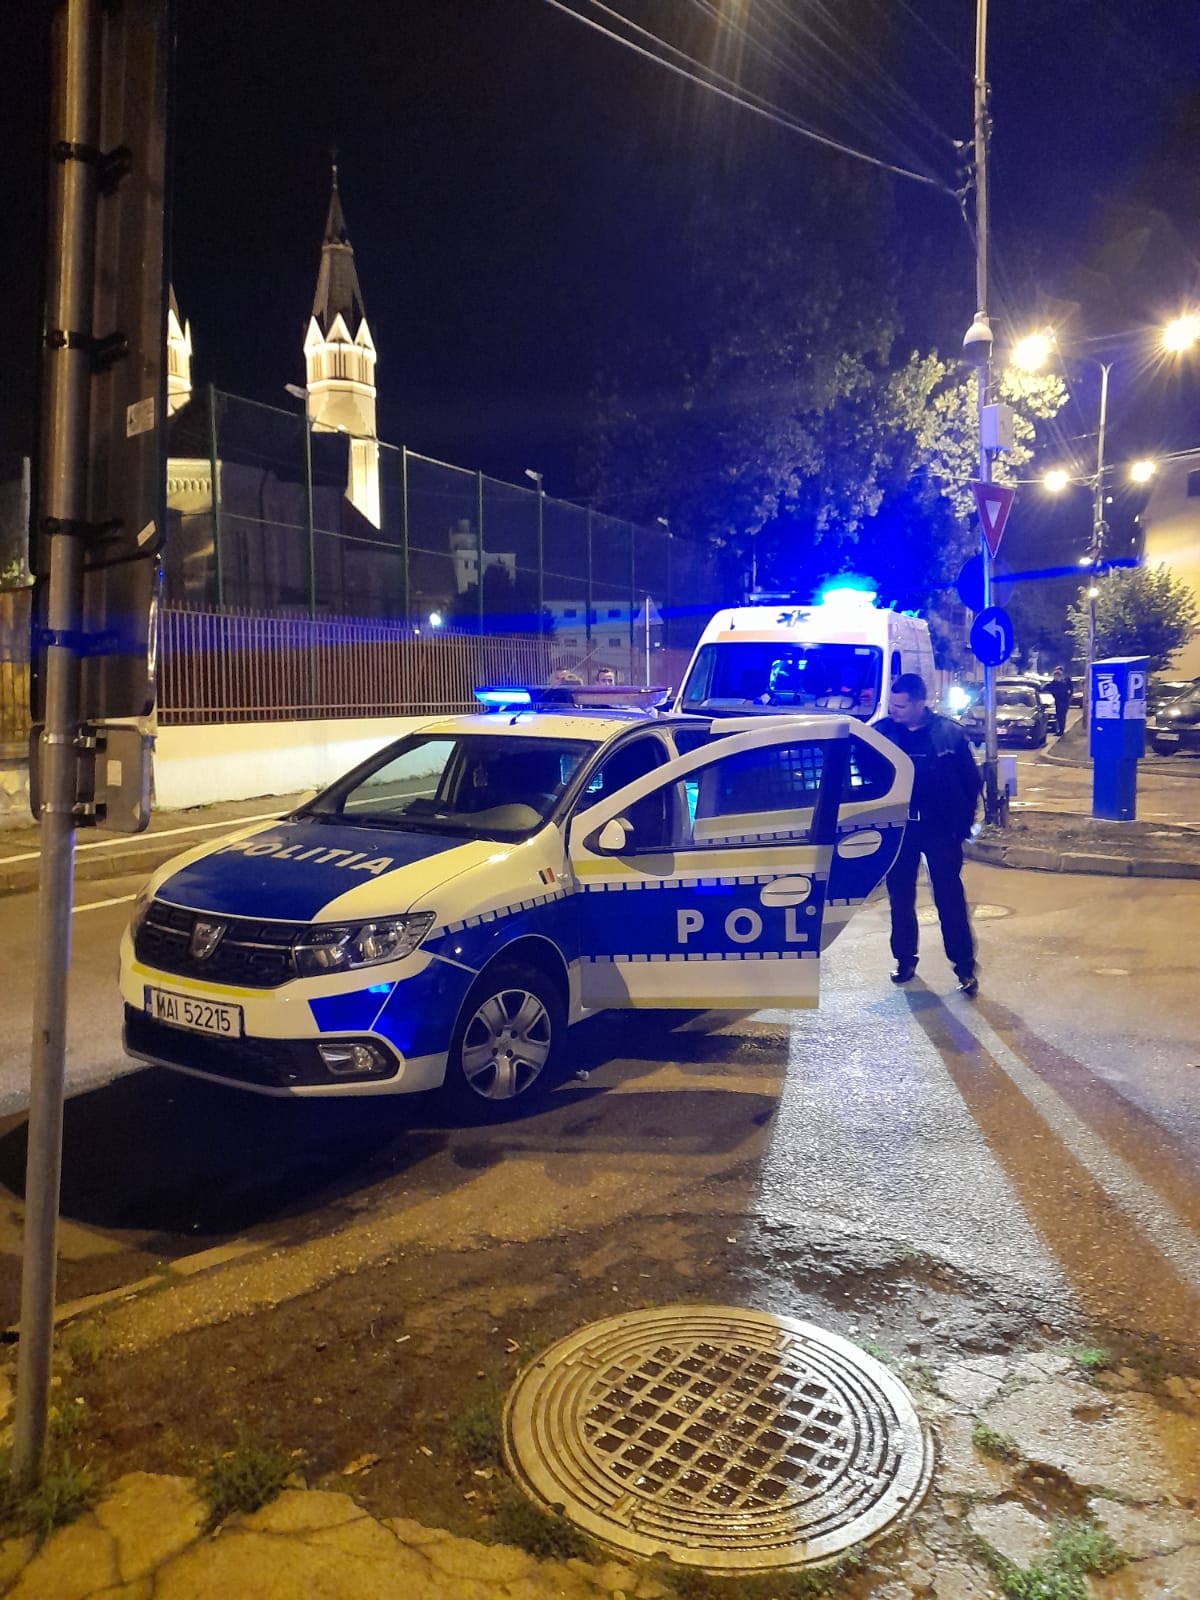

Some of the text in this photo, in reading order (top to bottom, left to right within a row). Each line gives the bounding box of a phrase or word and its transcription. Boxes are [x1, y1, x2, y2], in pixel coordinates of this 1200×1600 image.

[1130, 673, 1144, 699] P
[677, 908, 808, 943] POL
[157, 994, 230, 1031] MAI 52215
